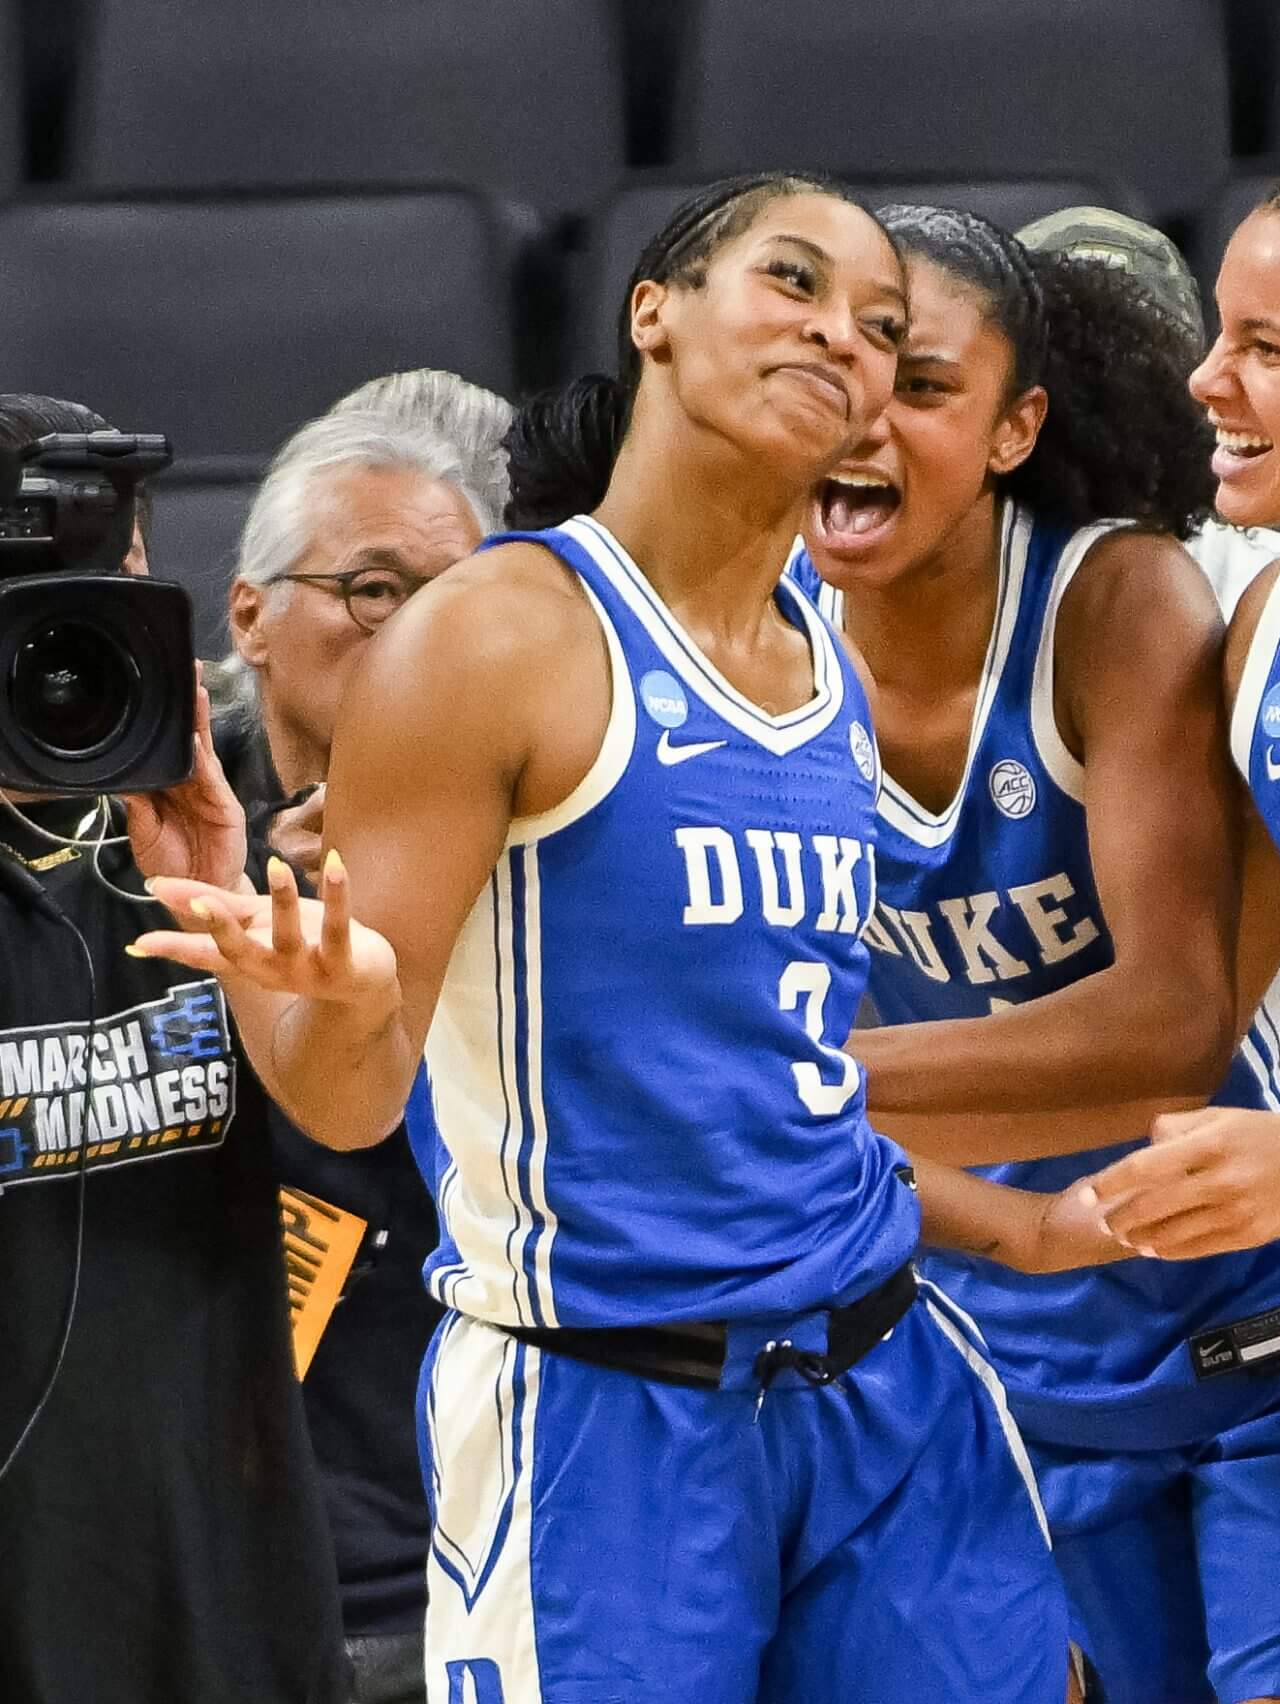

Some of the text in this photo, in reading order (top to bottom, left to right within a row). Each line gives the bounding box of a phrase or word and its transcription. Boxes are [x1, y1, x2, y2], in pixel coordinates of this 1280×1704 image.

[999, 775, 1029, 794] ACC
[675, 826, 876, 940] DUK
[0, 1020, 149, 1097] MARCH
[779, 961, 860, 1116] 3
[34, 1060, 229, 1152] MADNESS
